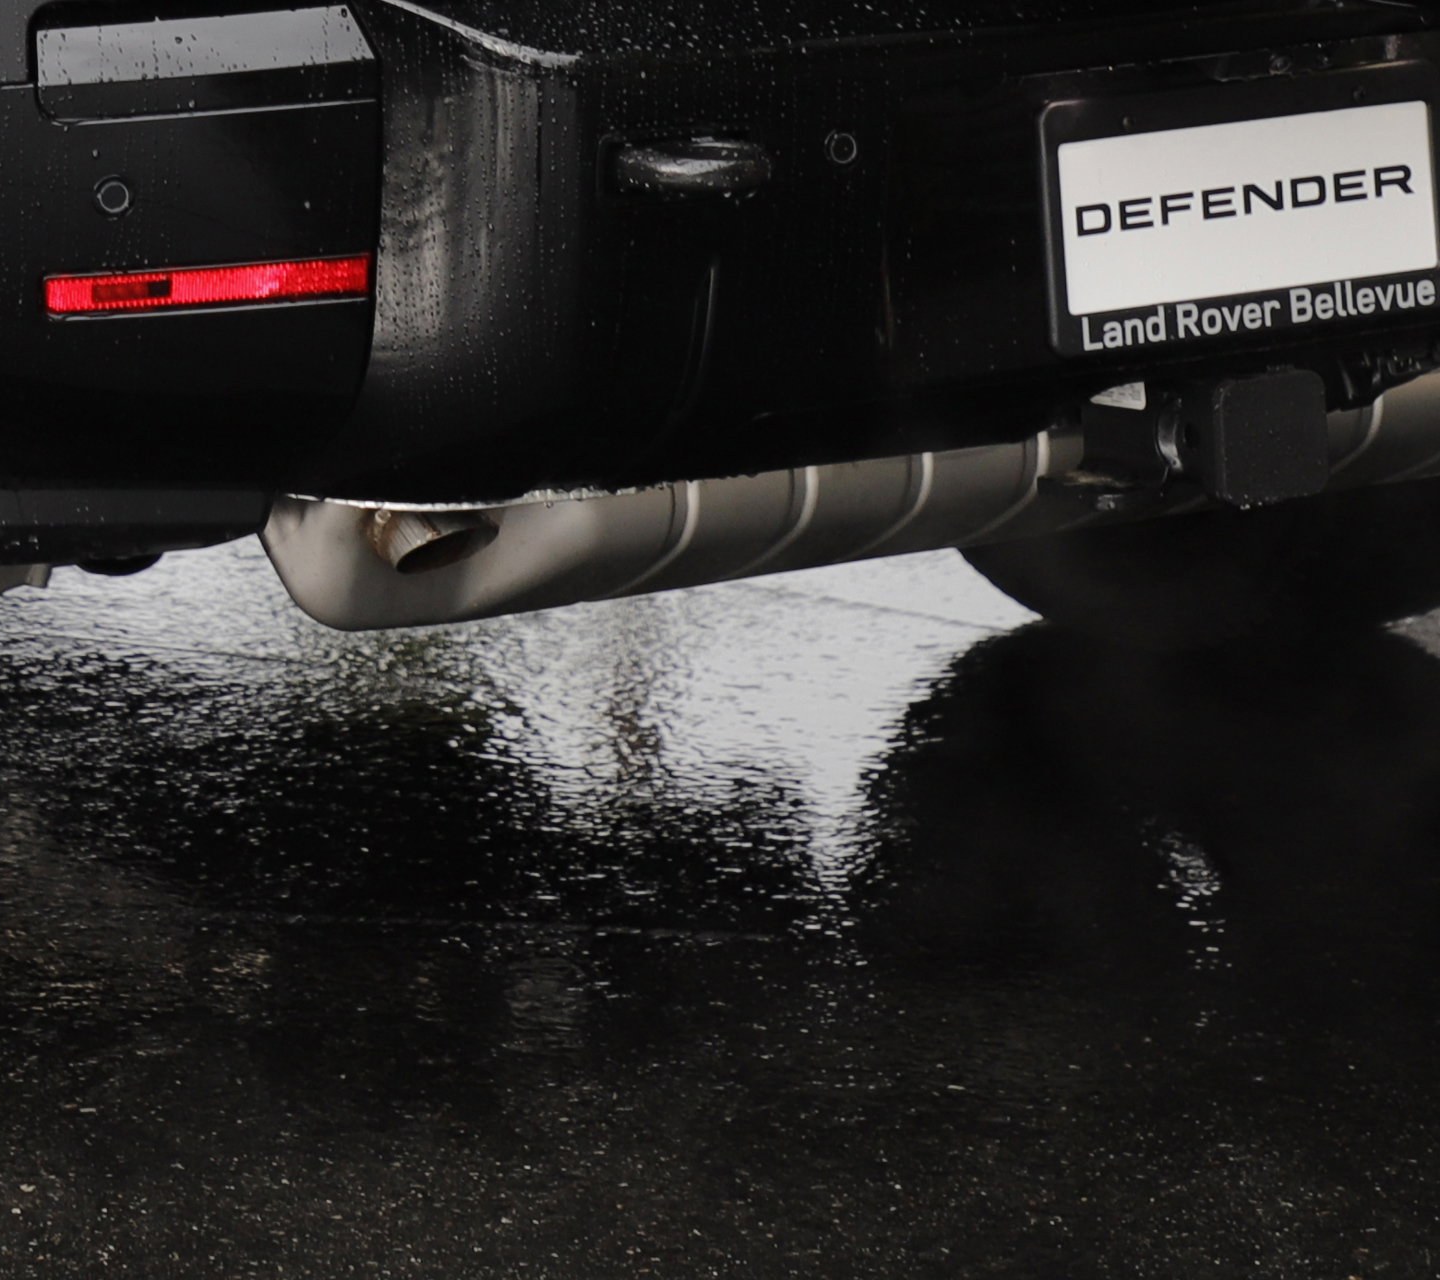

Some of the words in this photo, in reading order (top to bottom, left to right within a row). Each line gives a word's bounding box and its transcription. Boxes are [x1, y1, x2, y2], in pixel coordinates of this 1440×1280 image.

[1076, 165, 1414, 236] DEFENDER
[1082, 307, 1167, 352] Land
[1177, 299, 1281, 339] Rover
[1290, 279, 1437, 324] Bellevue
